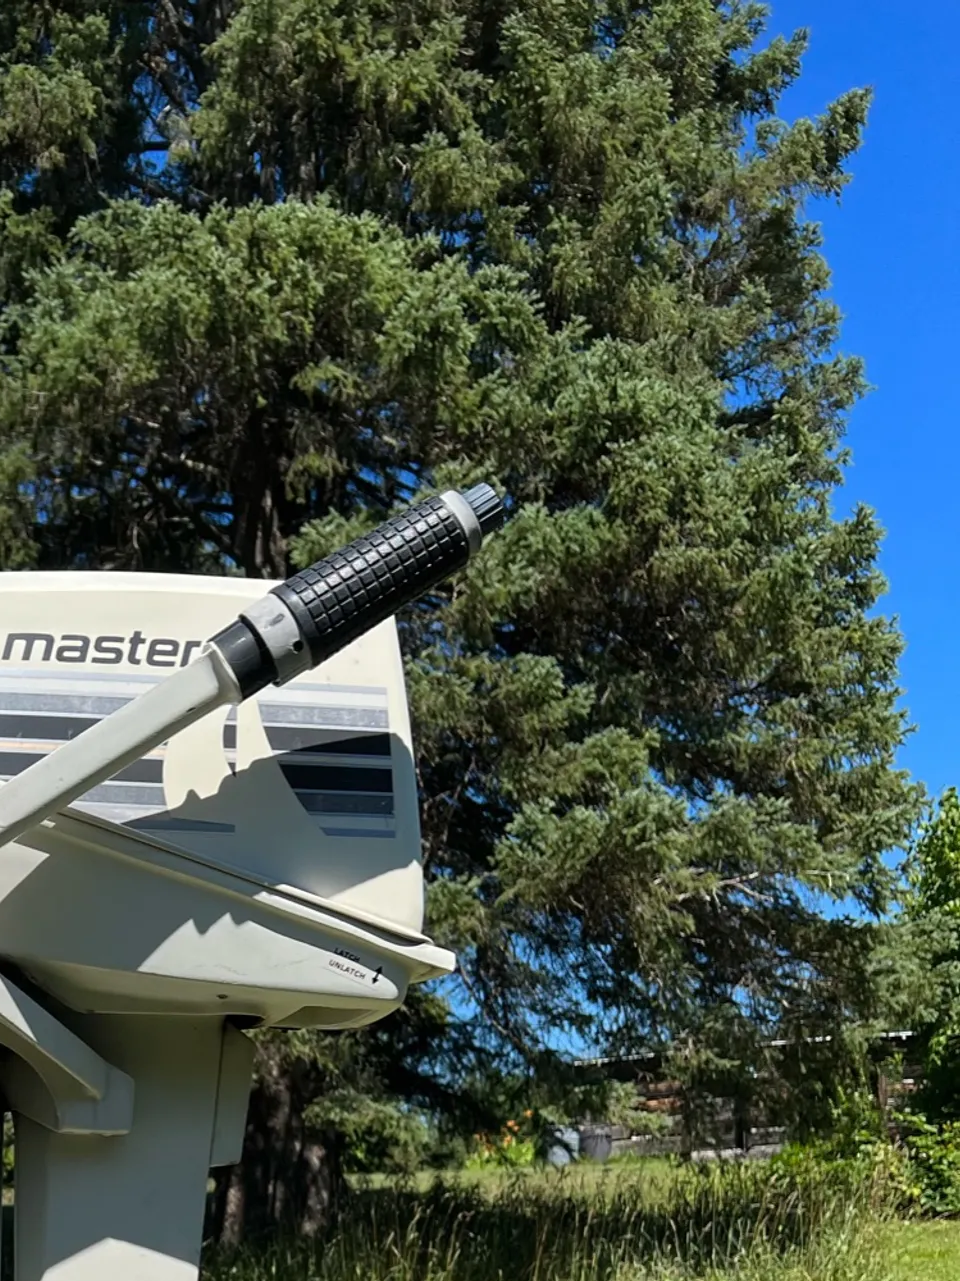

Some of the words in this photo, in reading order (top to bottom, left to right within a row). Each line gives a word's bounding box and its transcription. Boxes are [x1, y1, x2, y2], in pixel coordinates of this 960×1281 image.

[2, 630, 202, 668] master
[333, 948, 361, 964] LATCH
[328, 959, 367, 980] UNLATCH
